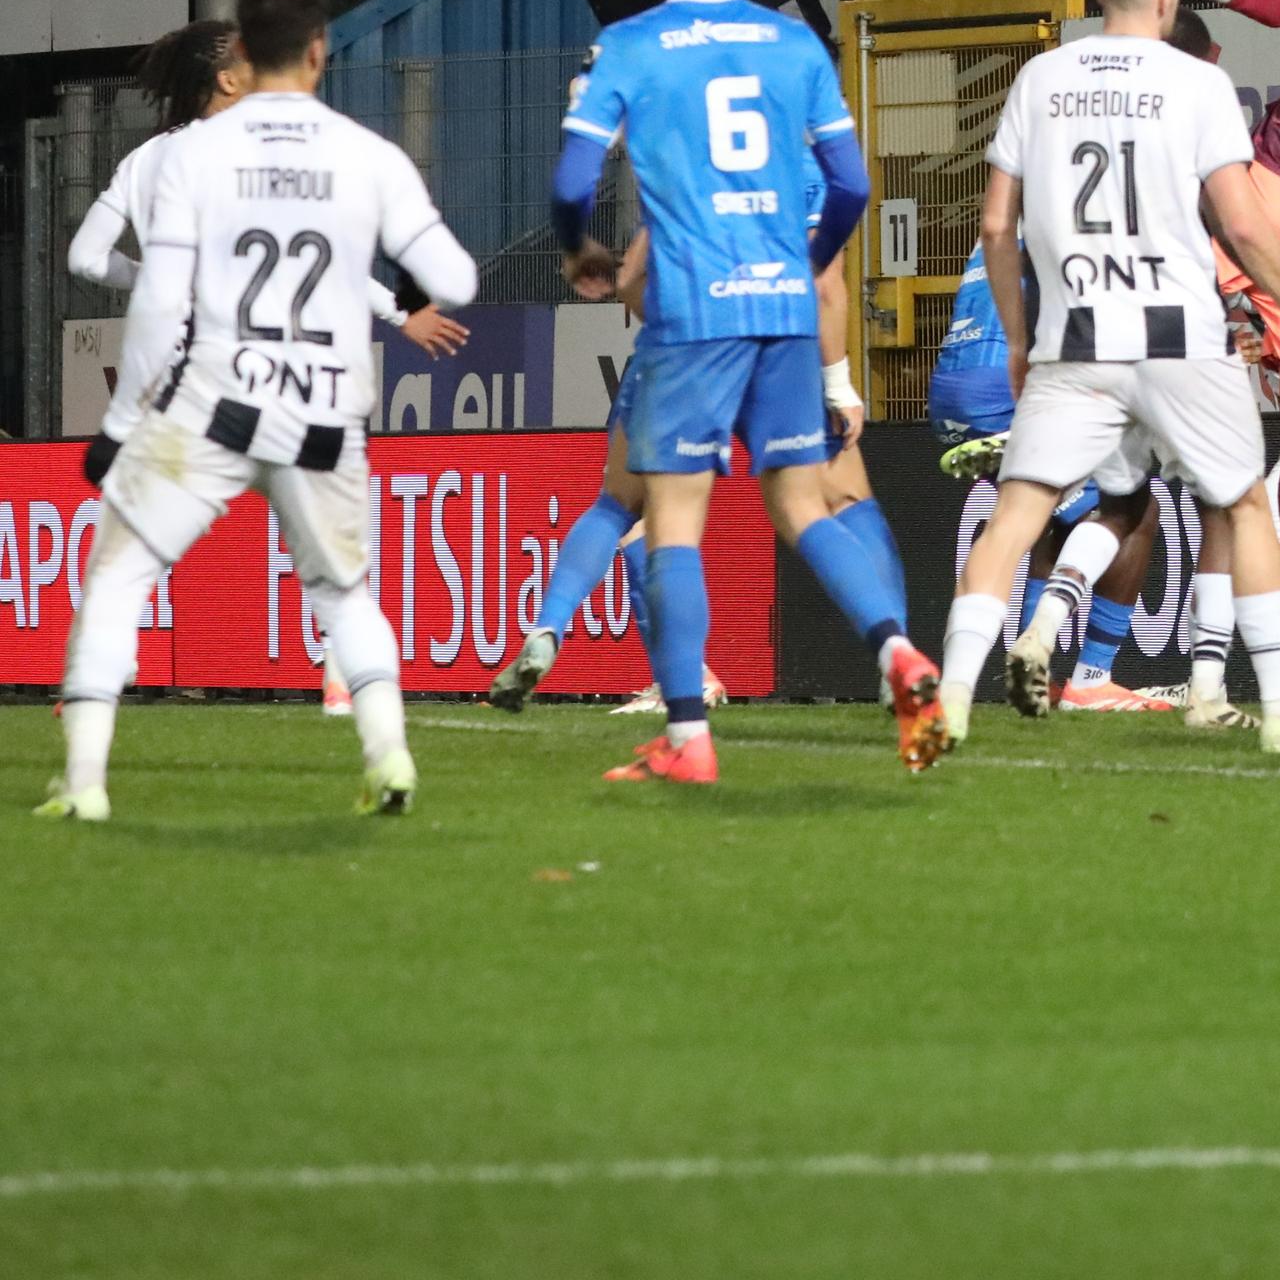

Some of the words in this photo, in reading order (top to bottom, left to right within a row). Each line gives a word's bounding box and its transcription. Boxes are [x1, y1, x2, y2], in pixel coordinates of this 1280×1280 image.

[705, 76, 770, 172] 6
[1049, 91, 1165, 121] SCHEIDLER
[1072, 140, 1139, 236] 21
[889, 213, 909, 263] 11
[233, 228, 333, 347] 22
